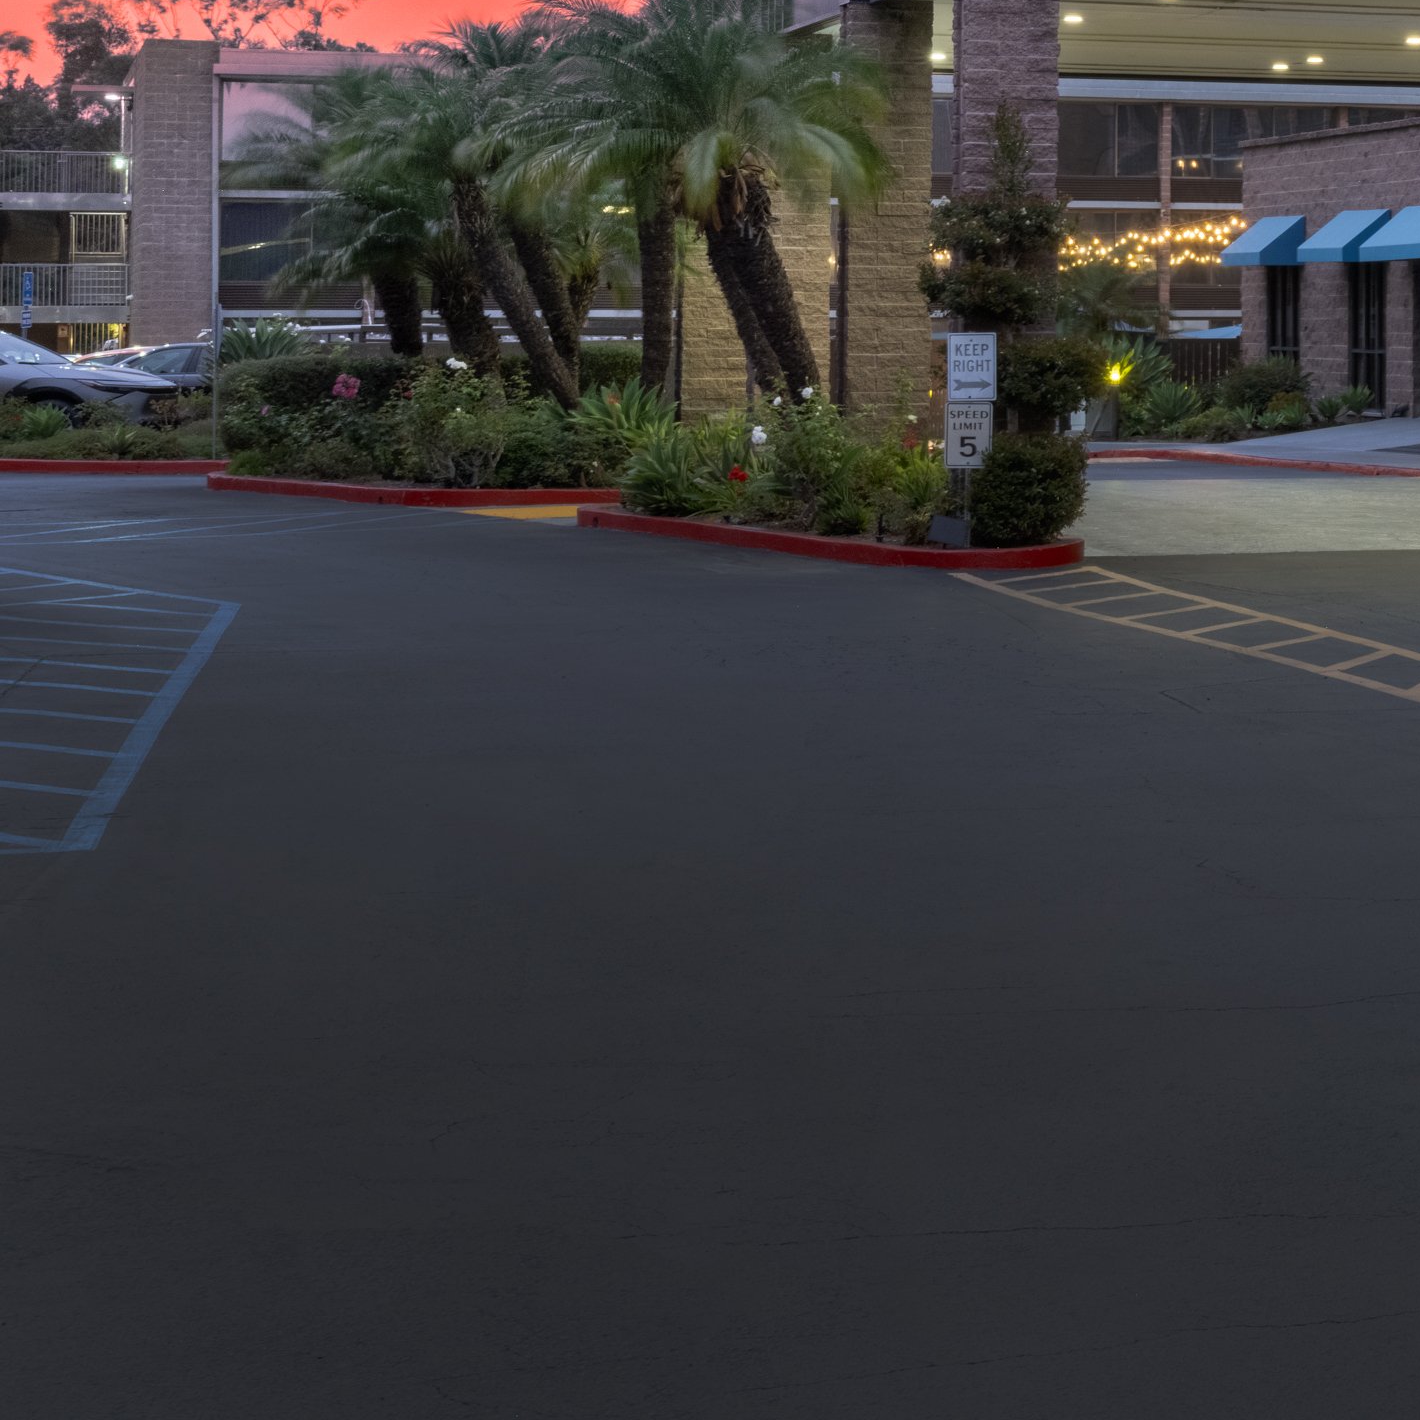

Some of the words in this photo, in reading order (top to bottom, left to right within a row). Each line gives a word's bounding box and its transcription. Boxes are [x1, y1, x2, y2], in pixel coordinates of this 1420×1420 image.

[955, 343, 989, 357] KEEP
[953, 359, 992, 373] RIGHT
[950, 410, 989, 419] SPEED
[953, 422, 984, 431] LIMIT
[959, 436, 977, 457] 5
